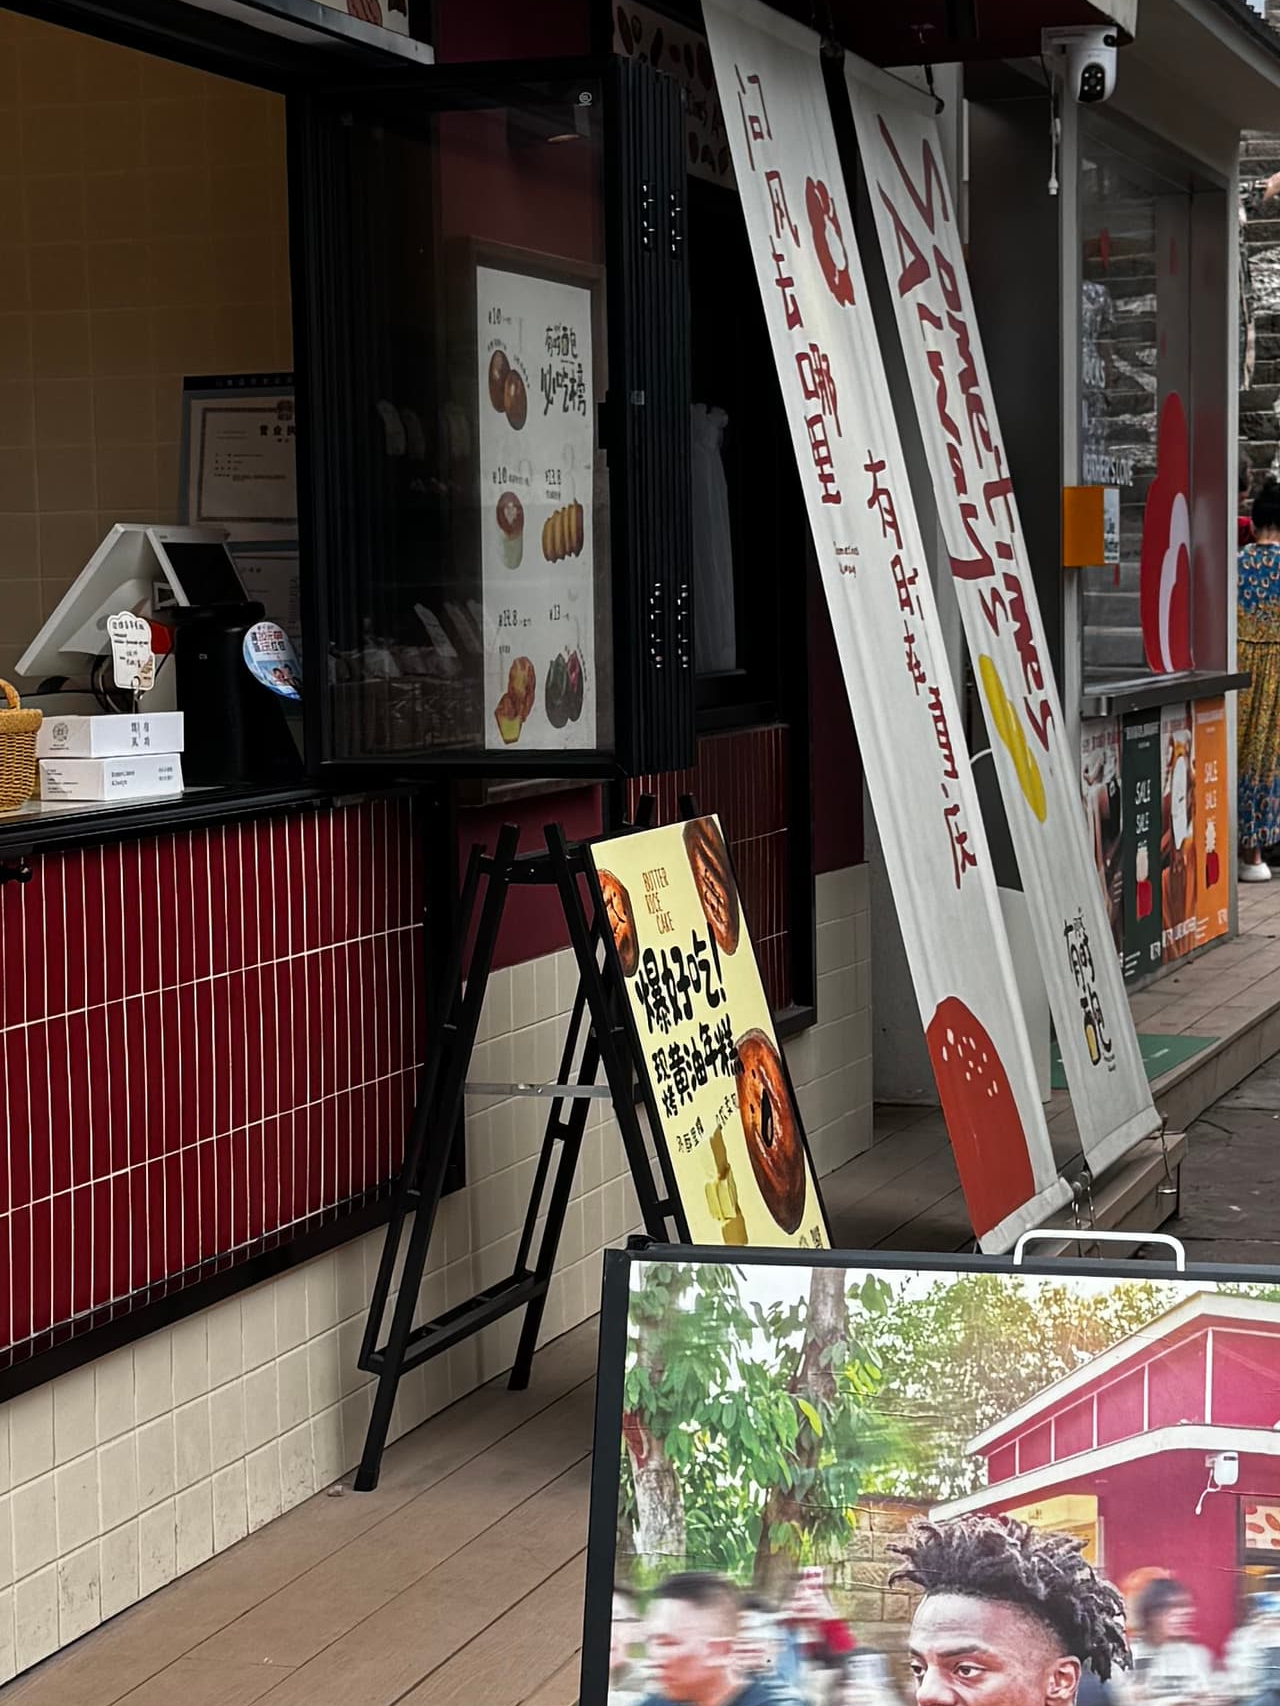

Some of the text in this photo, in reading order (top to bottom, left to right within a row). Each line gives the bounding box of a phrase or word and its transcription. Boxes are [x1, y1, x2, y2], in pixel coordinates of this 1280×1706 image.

[877, 113, 1057, 755] Sometimes
[642, 867, 669, 893] BUTTER
[645, 892, 663, 915] RICE
[656, 911, 675, 935] CAKE
